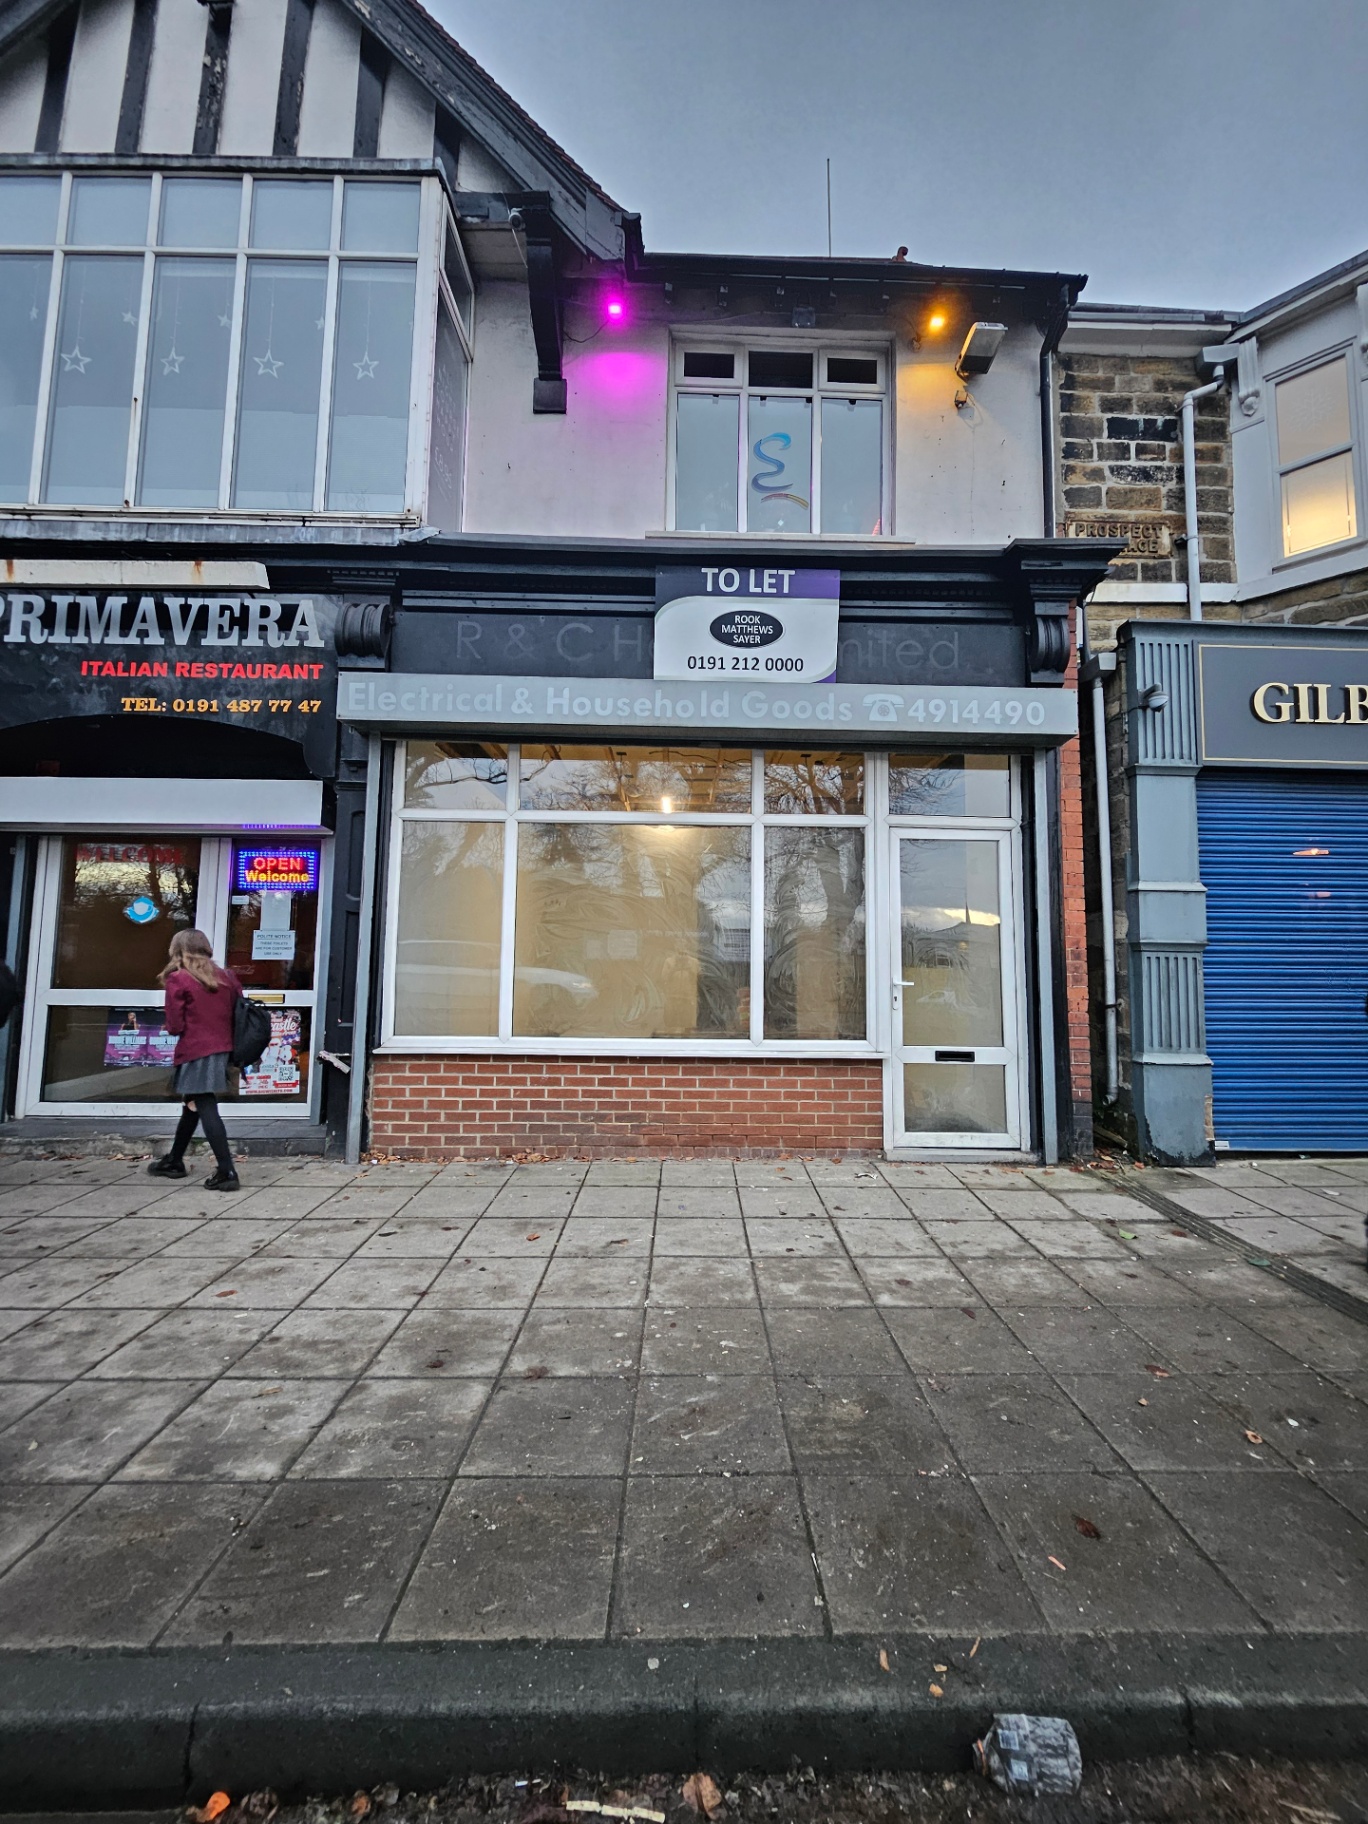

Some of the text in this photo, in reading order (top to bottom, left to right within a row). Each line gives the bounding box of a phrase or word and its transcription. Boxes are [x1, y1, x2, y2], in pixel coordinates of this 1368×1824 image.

[1075, 523, 1162, 539] PROSPECT
[701, 567, 796, 594] TO LET
[0, 594, 325, 648] RIMAVERA
[734, 614, 761, 625] ROOK
[721, 624, 774, 635] MATTHEWS
[456, 620, 482, 660] R
[503, 623, 537, 660] &
[556, 622, 594, 662] C
[732, 634, 761, 644] SAYER
[81, 660, 323, 680] ITALIAN RESTAURANT
[687, 655, 804, 672] 0191 212 0000
[121, 697, 322, 714] TEL: 0191 487 77 47
[348, 682, 1046, 727] Electrical & Household Goods 4914490
[253, 857, 304, 871] OPEN
[245, 869, 310, 883] Welcome
